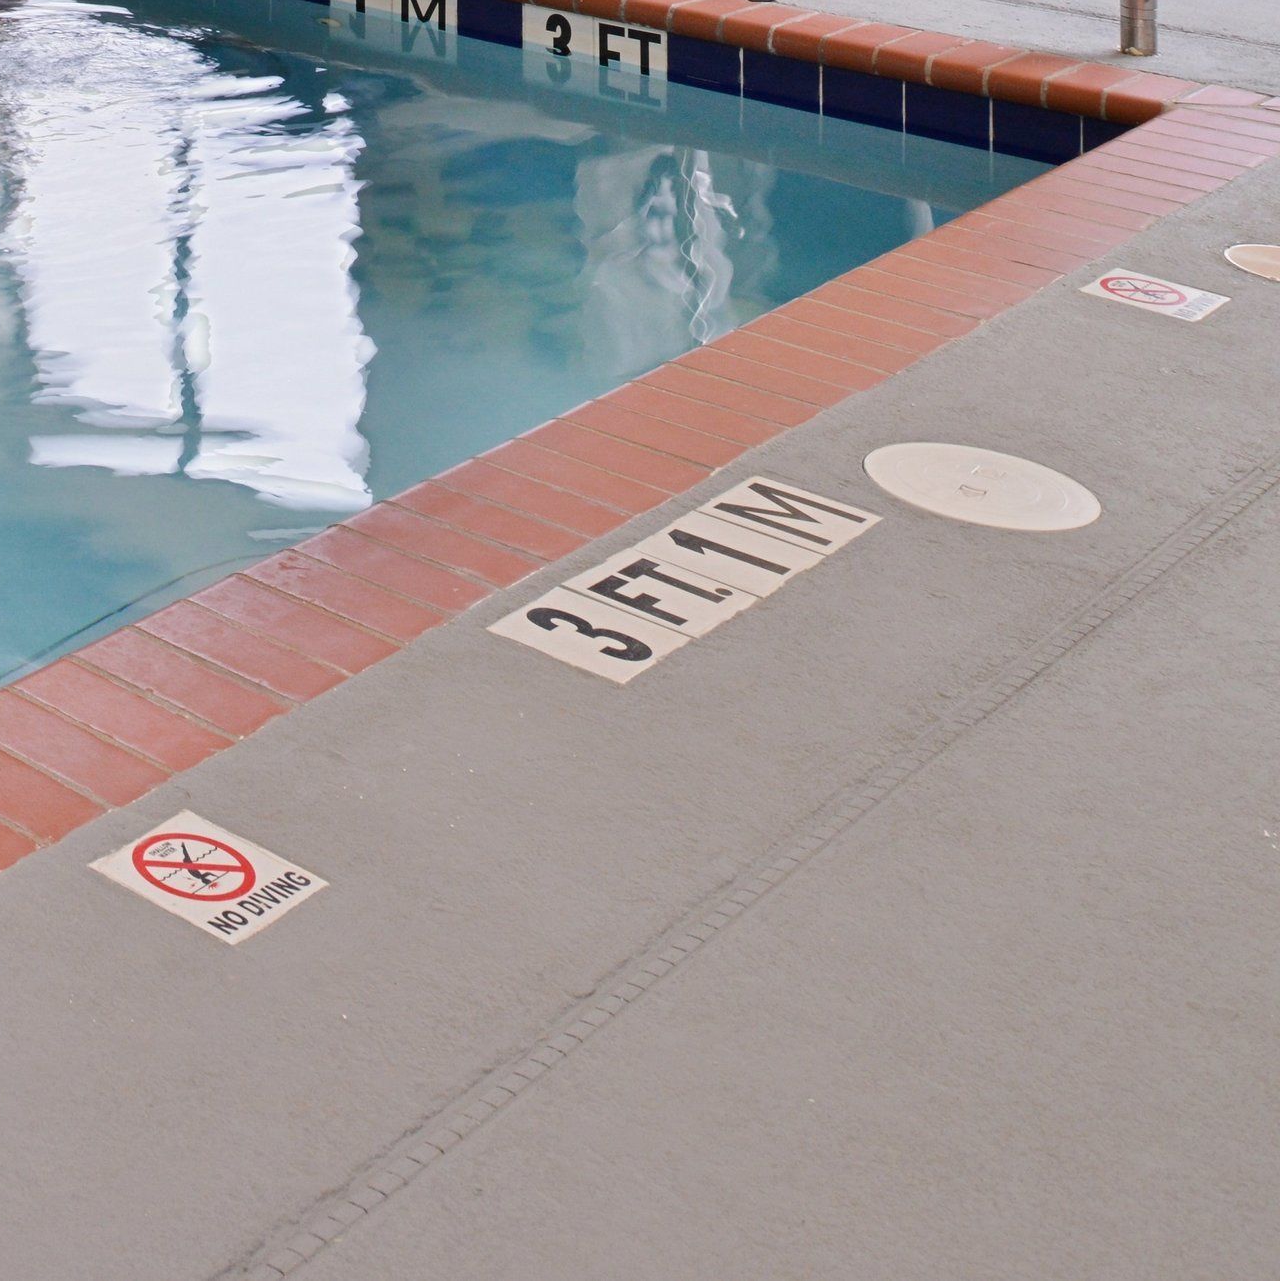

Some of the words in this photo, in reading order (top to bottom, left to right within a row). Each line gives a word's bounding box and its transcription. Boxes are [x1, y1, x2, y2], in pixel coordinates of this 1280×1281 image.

[546, 14, 572, 56] 3
[599, 22, 661, 76] FT
[527, 607, 652, 661] 3
[714, 483, 867, 546] M
[207, 910, 248, 934] NO
[237, 872, 311, 916] DIVING
